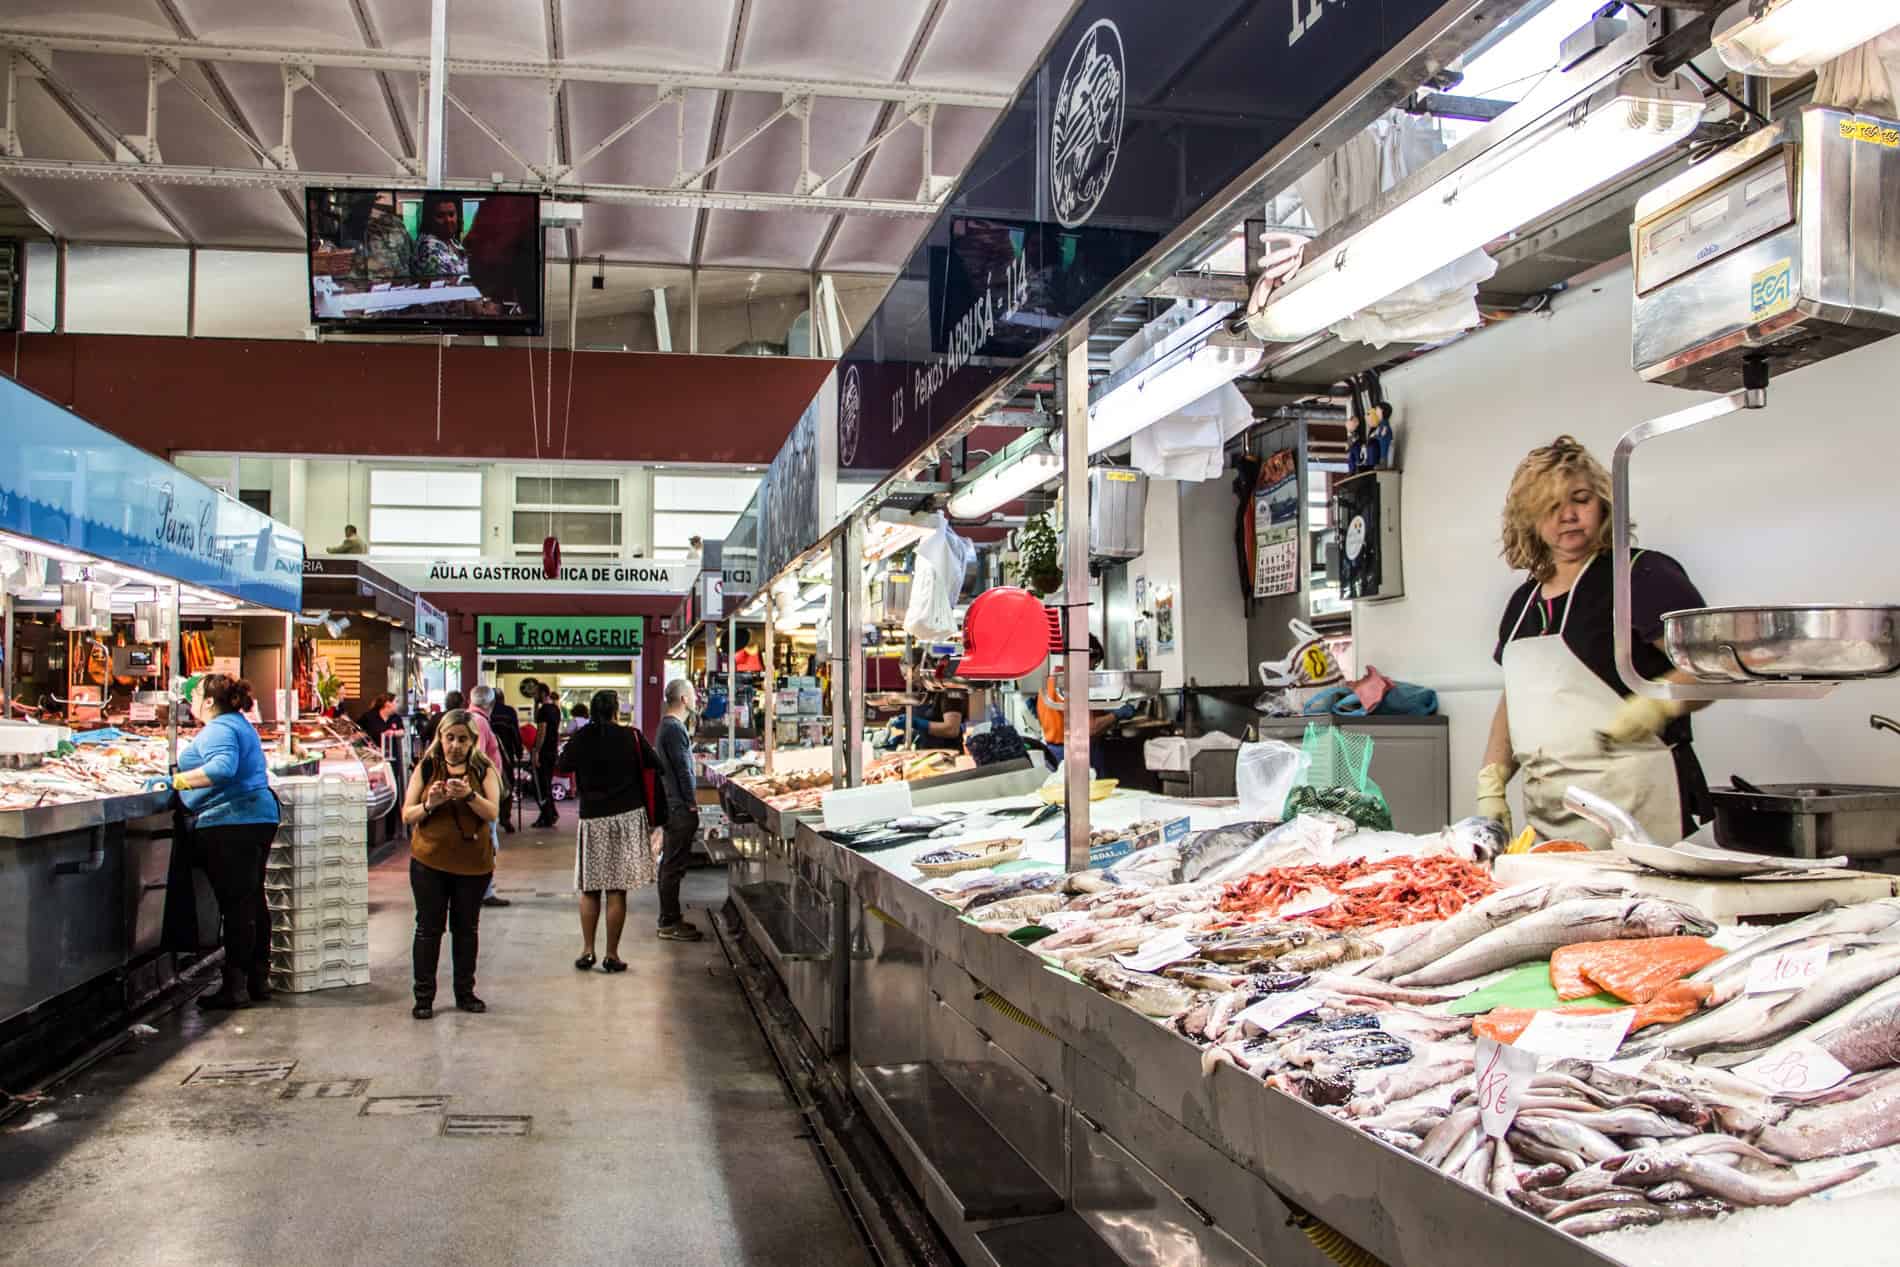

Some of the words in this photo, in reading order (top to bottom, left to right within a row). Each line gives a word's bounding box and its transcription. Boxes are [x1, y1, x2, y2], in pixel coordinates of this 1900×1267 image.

[891, 387, 904, 433] 113
[914, 357, 944, 412] Peixos
[1006, 248, 1028, 321] 114
[302, 560, 324, 572] RIA
[430, 566, 468, 580] AULA
[473, 566, 588, 581] GASTRONICA
[592, 568, 610, 581] DE
[614, 568, 669, 582] GIRONA
